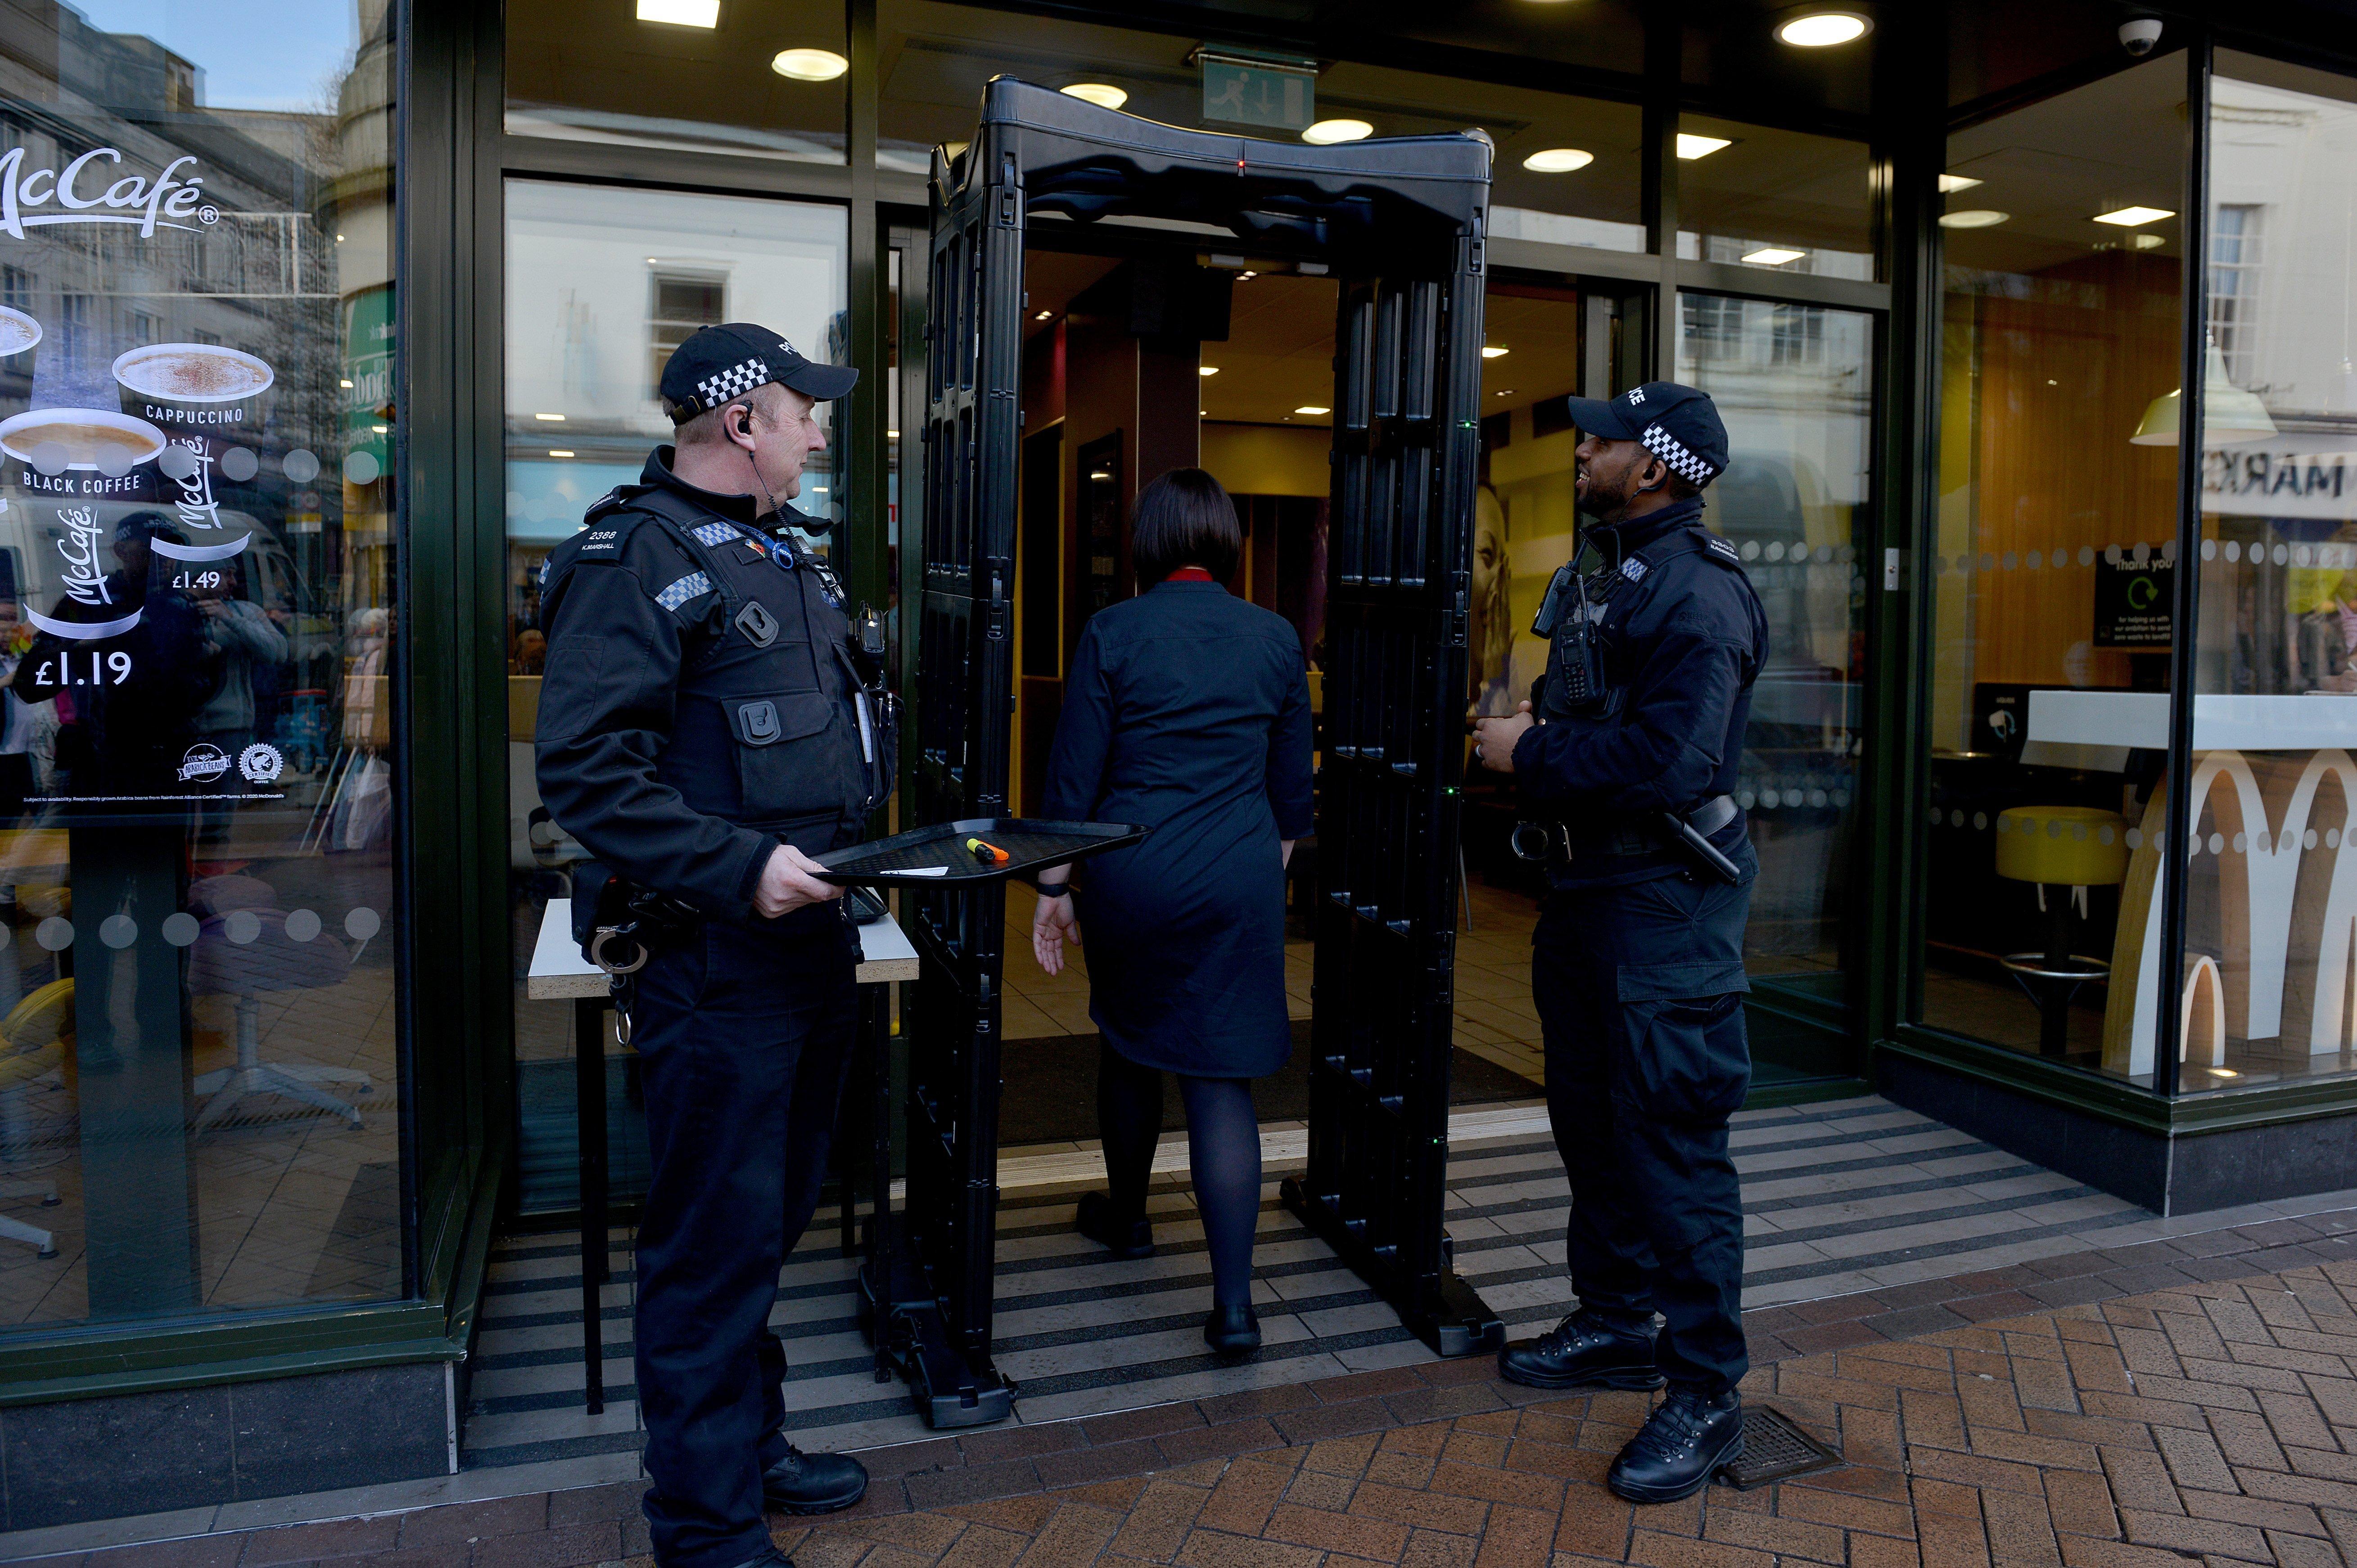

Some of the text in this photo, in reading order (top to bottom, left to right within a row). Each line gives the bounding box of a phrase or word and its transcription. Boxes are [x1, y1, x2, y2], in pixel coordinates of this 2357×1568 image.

[778, 341, 798, 355] PO
[1628, 386, 1646, 406] ICE
[146, 405, 243, 424] CAPPUCCINO
[23, 471, 140, 494] BLACK COFFEE
[589, 531, 617, 540] 2388
[727, 521, 767, 541] SHIRE POLICE
[2115, 559, 2173, 573] Thank you
[172, 571, 220, 589] £1.49
[36, 651, 132, 685] £1.19
[244, 748, 278, 767] RAINFOREST ALLIANCE
[185, 761, 225, 774] ARABICA BEANS
